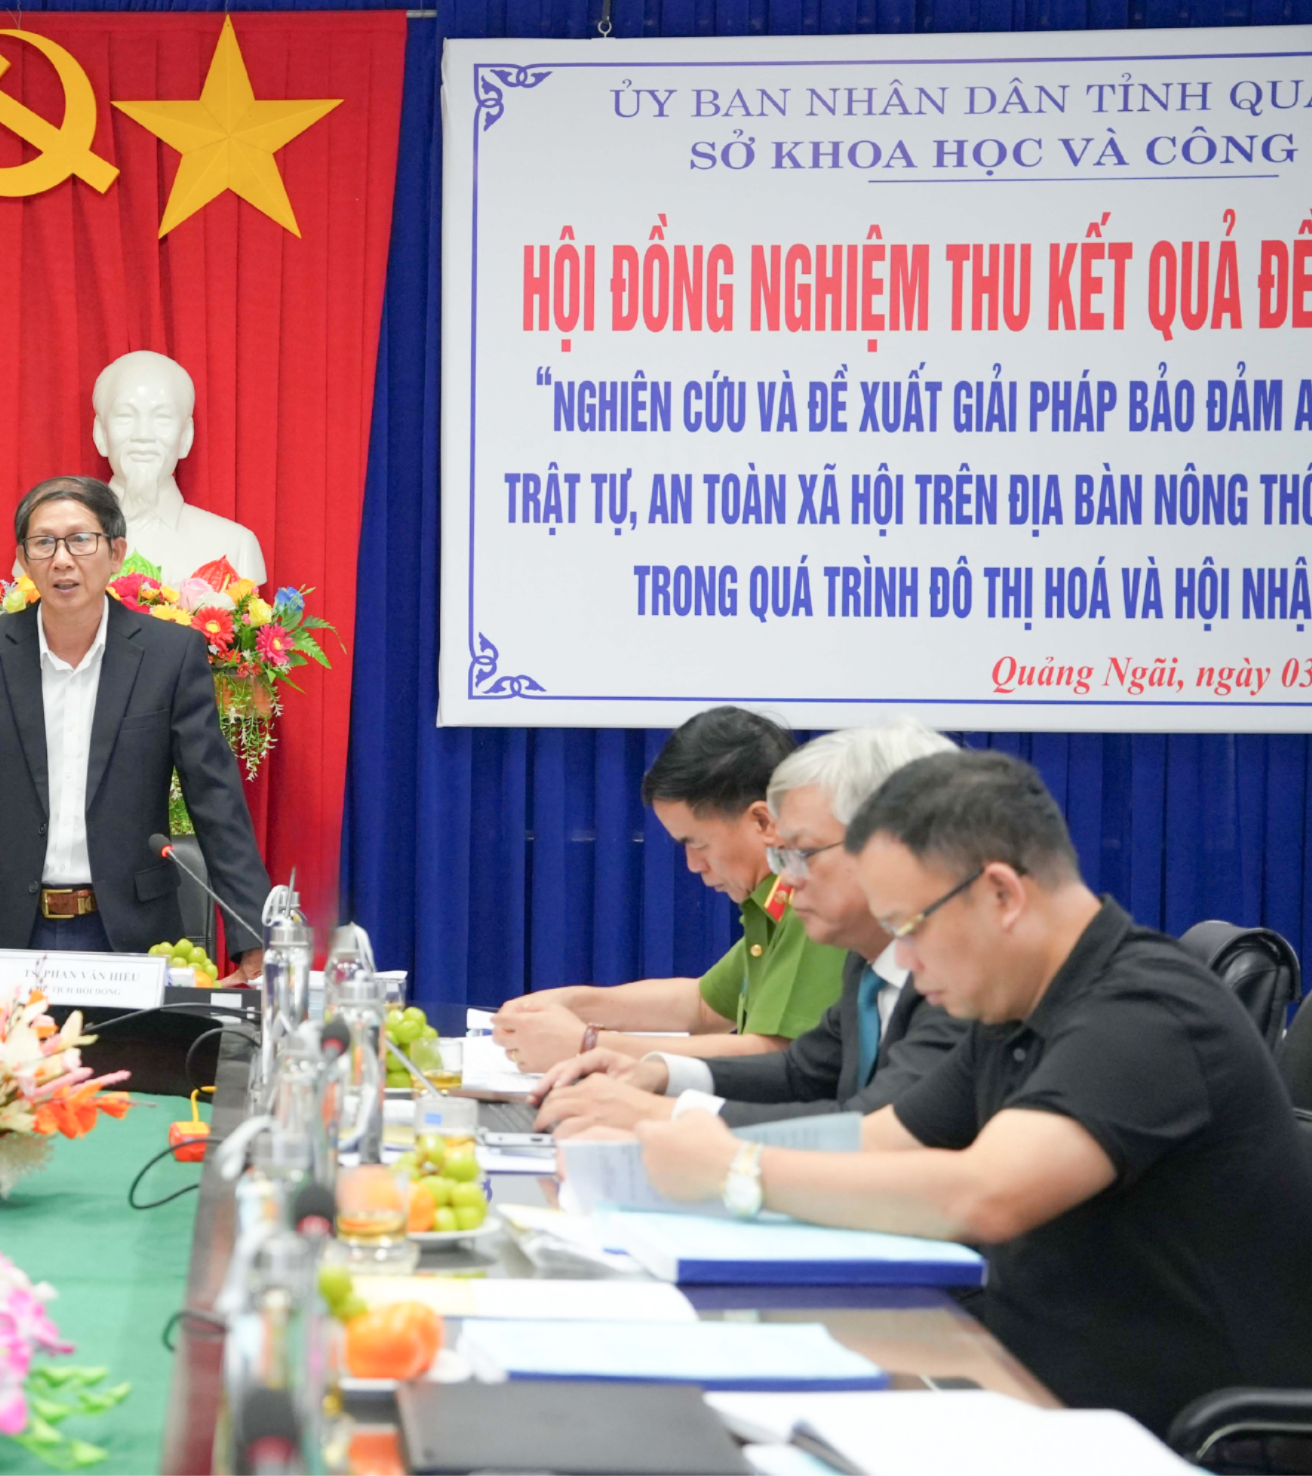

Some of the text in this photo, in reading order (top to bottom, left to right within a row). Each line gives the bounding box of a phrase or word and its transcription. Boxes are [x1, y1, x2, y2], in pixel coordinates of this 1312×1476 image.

[609, 78, 677, 118] ỦY
[692, 89, 789, 118] BAN
[806, 79, 948, 117] NHÂN
[964, 78, 1068, 115] DÂN
[1086, 72, 1212, 113] TỈNH
[690, 126, 1297, 176] SỞ KHOA HỌC VÀ CÔNG
[523, 209, 1312, 352] HỘI ĐỒNG NGHIỆM THU KẾT QUẢ ĐỀ
[683, 366, 746, 433] CỨU
[757, 370, 798, 432] VÀ
[807, 364, 848, 432] ĐỀ
[859, 362, 942, 433] XUẤT
[953, 362, 1017, 433] GIẢI
[1029, 369, 1117, 432] PHÁP
[1129, 361, 1195, 432] BẢO
[1206, 361, 1283, 432] ĐẢM
[504, 461, 581, 536] TRẬT
[591, 468, 637, 536] TỰ,
[648, 474, 692, 524] AN
[703, 462, 786, 525] TOÀN
[797, 463, 840, 525] XÃ
[851, 462, 904, 537] HỘI
[915, 463, 997, 525] TRÊN
[1008, 474, 1063, 538] ĐỊA
[1075, 462, 1143, 525] BÀN
[1154, 462, 1248, 526] NÔNG
[634, 565, 738, 617] TRONG
[749, 554, 813, 623] QUÁ
[823, 555, 918, 618] TRÌNH
[929, 555, 972, 619] ĐÔ
[983, 567, 1033, 631] THỊ
[1045, 556, 1111, 619] HOÁ
[1121, 556, 1163, 619] VÀ
[1175, 556, 1229, 632] HỘI
[992, 656, 1094, 694] Quảng
[1102, 657, 1185, 693] Ngãi,
[1196, 657, 1271, 696] ngày
